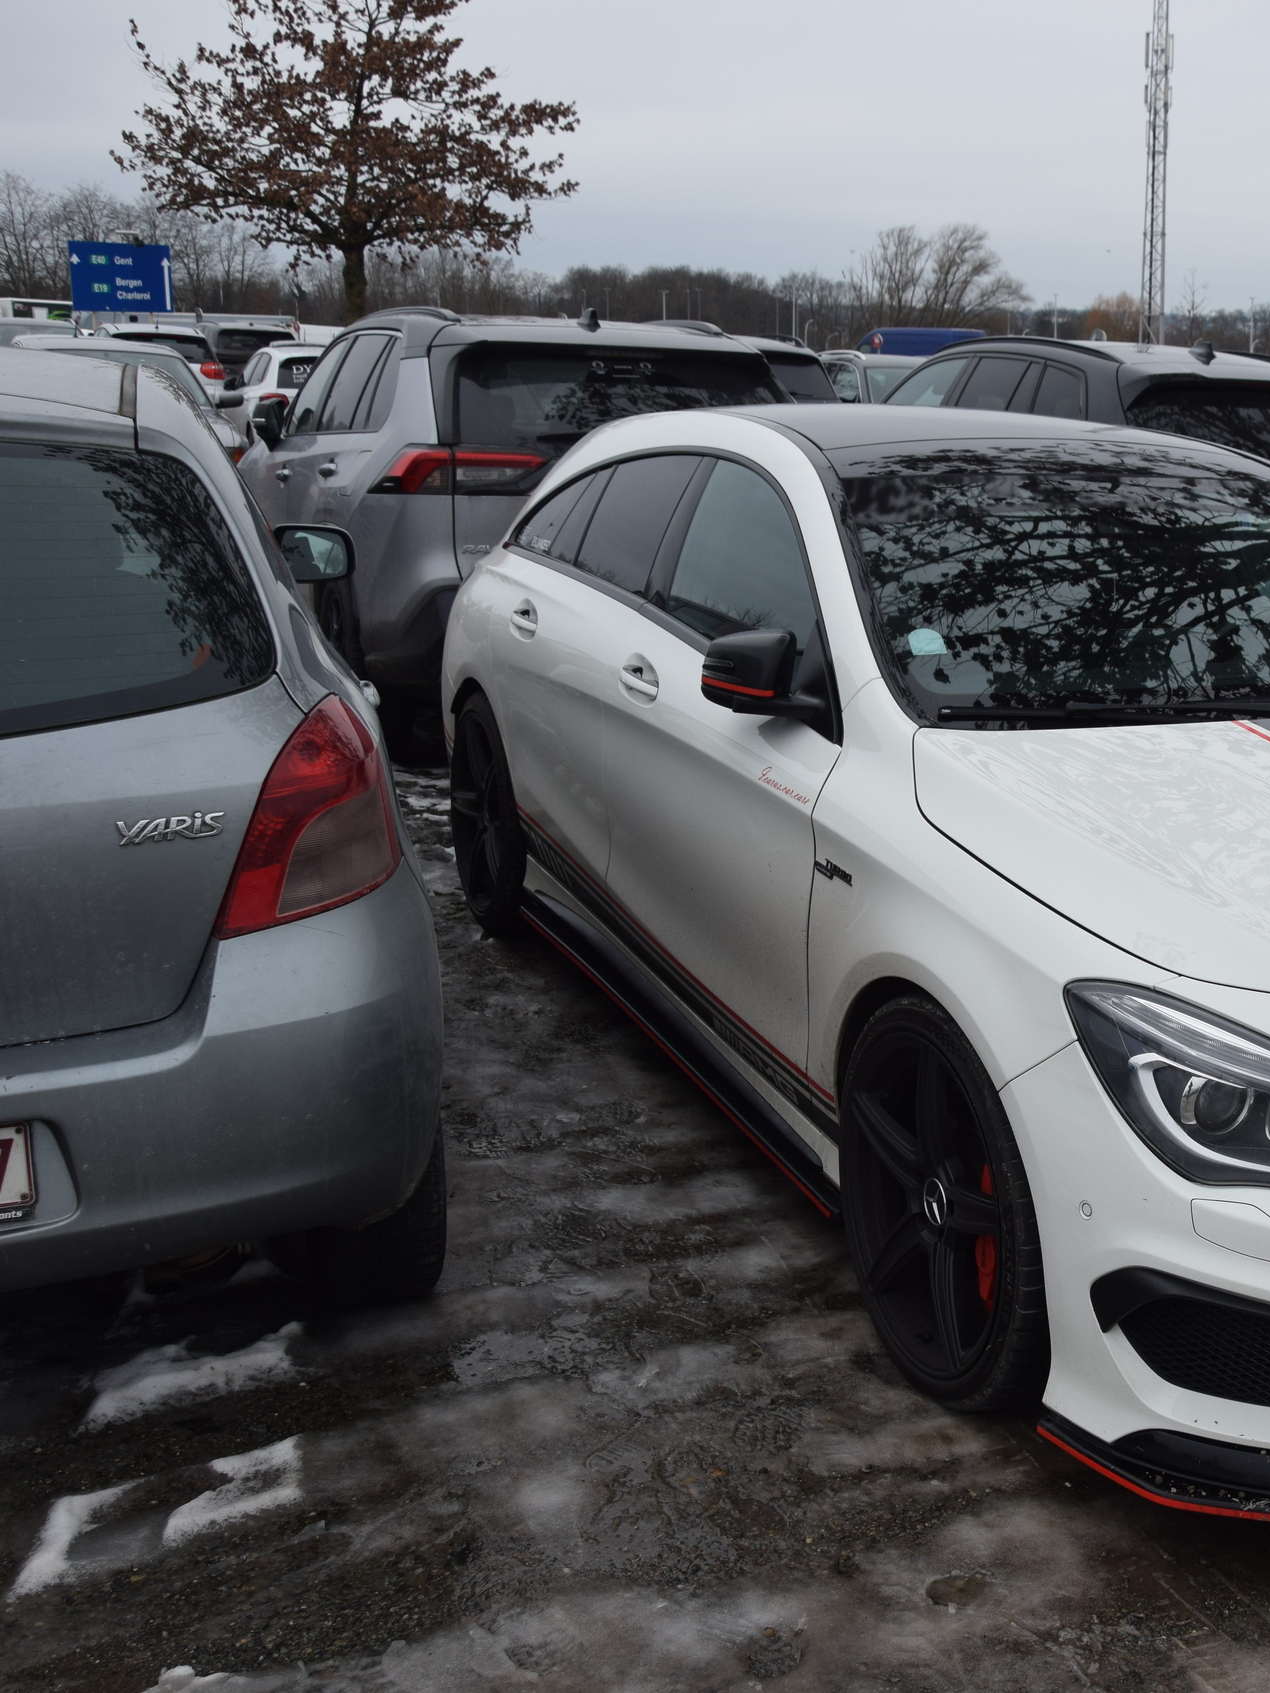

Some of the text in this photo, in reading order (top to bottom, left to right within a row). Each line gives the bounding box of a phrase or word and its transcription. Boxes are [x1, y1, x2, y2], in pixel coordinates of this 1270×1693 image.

[92, 255, 133, 266] E40 Gent
[94, 283, 108, 292] E19
[115, 277, 143, 288] Bergen
[117, 291, 151, 300] Charleroi
